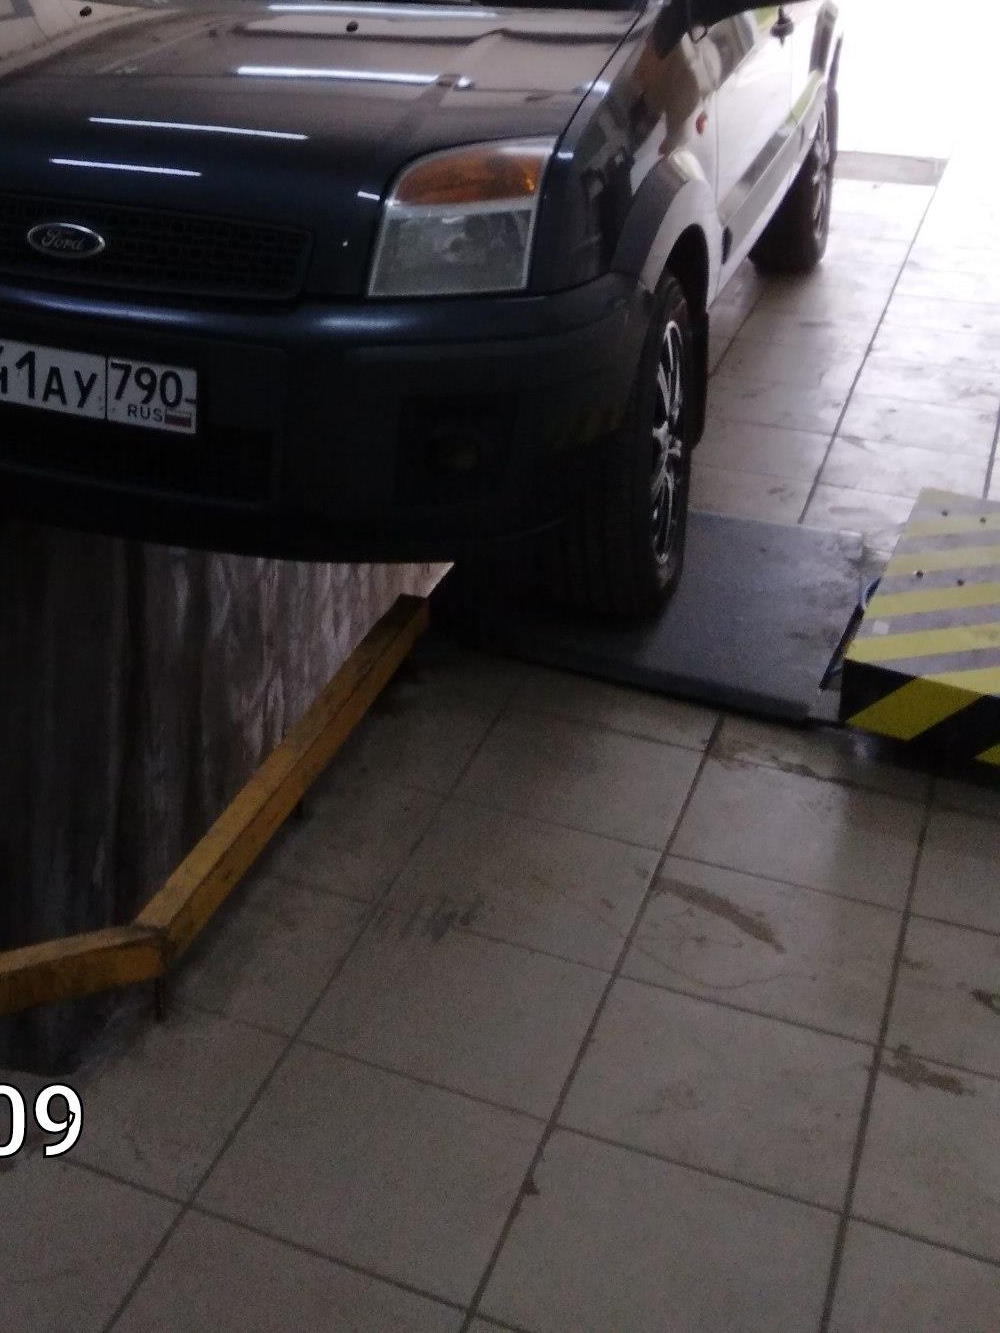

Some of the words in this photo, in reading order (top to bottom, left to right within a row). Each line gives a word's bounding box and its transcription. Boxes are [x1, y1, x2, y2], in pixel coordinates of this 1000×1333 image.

[40, 229, 85, 252] Ford
[110, 362, 184, 409] 790
[127, 403, 164, 423] RUS
